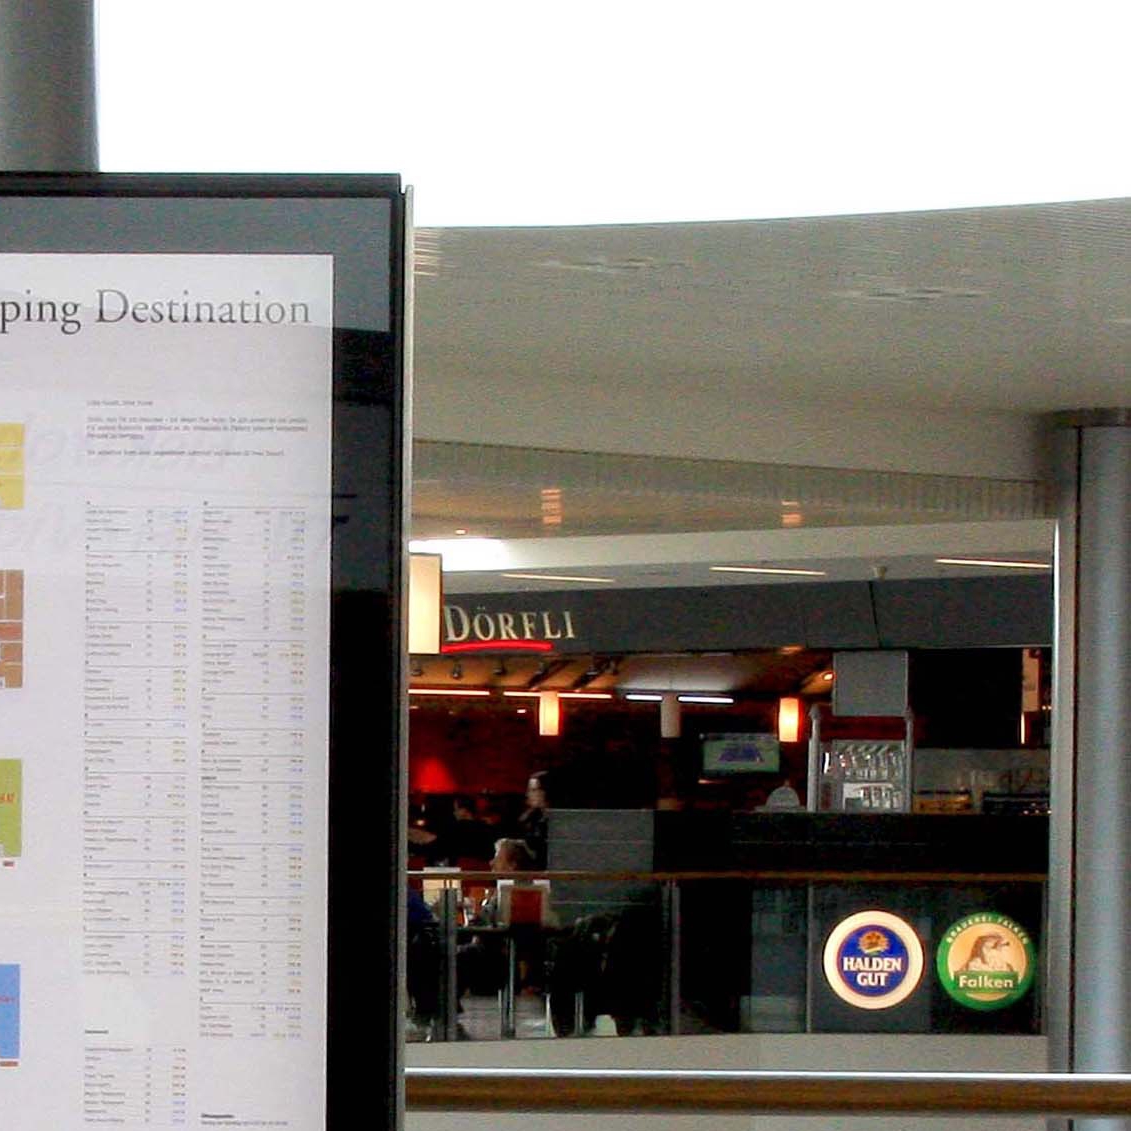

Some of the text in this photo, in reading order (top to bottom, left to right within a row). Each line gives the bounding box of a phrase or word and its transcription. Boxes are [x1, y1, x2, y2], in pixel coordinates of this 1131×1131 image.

[94, 288, 311, 325] Destination
[443, 605, 576, 642] DÖRFLI
[842, 957, 903, 972] HALDEN
[856, 973, 889, 987] GUT
[958, 975, 1014, 989] Falken
